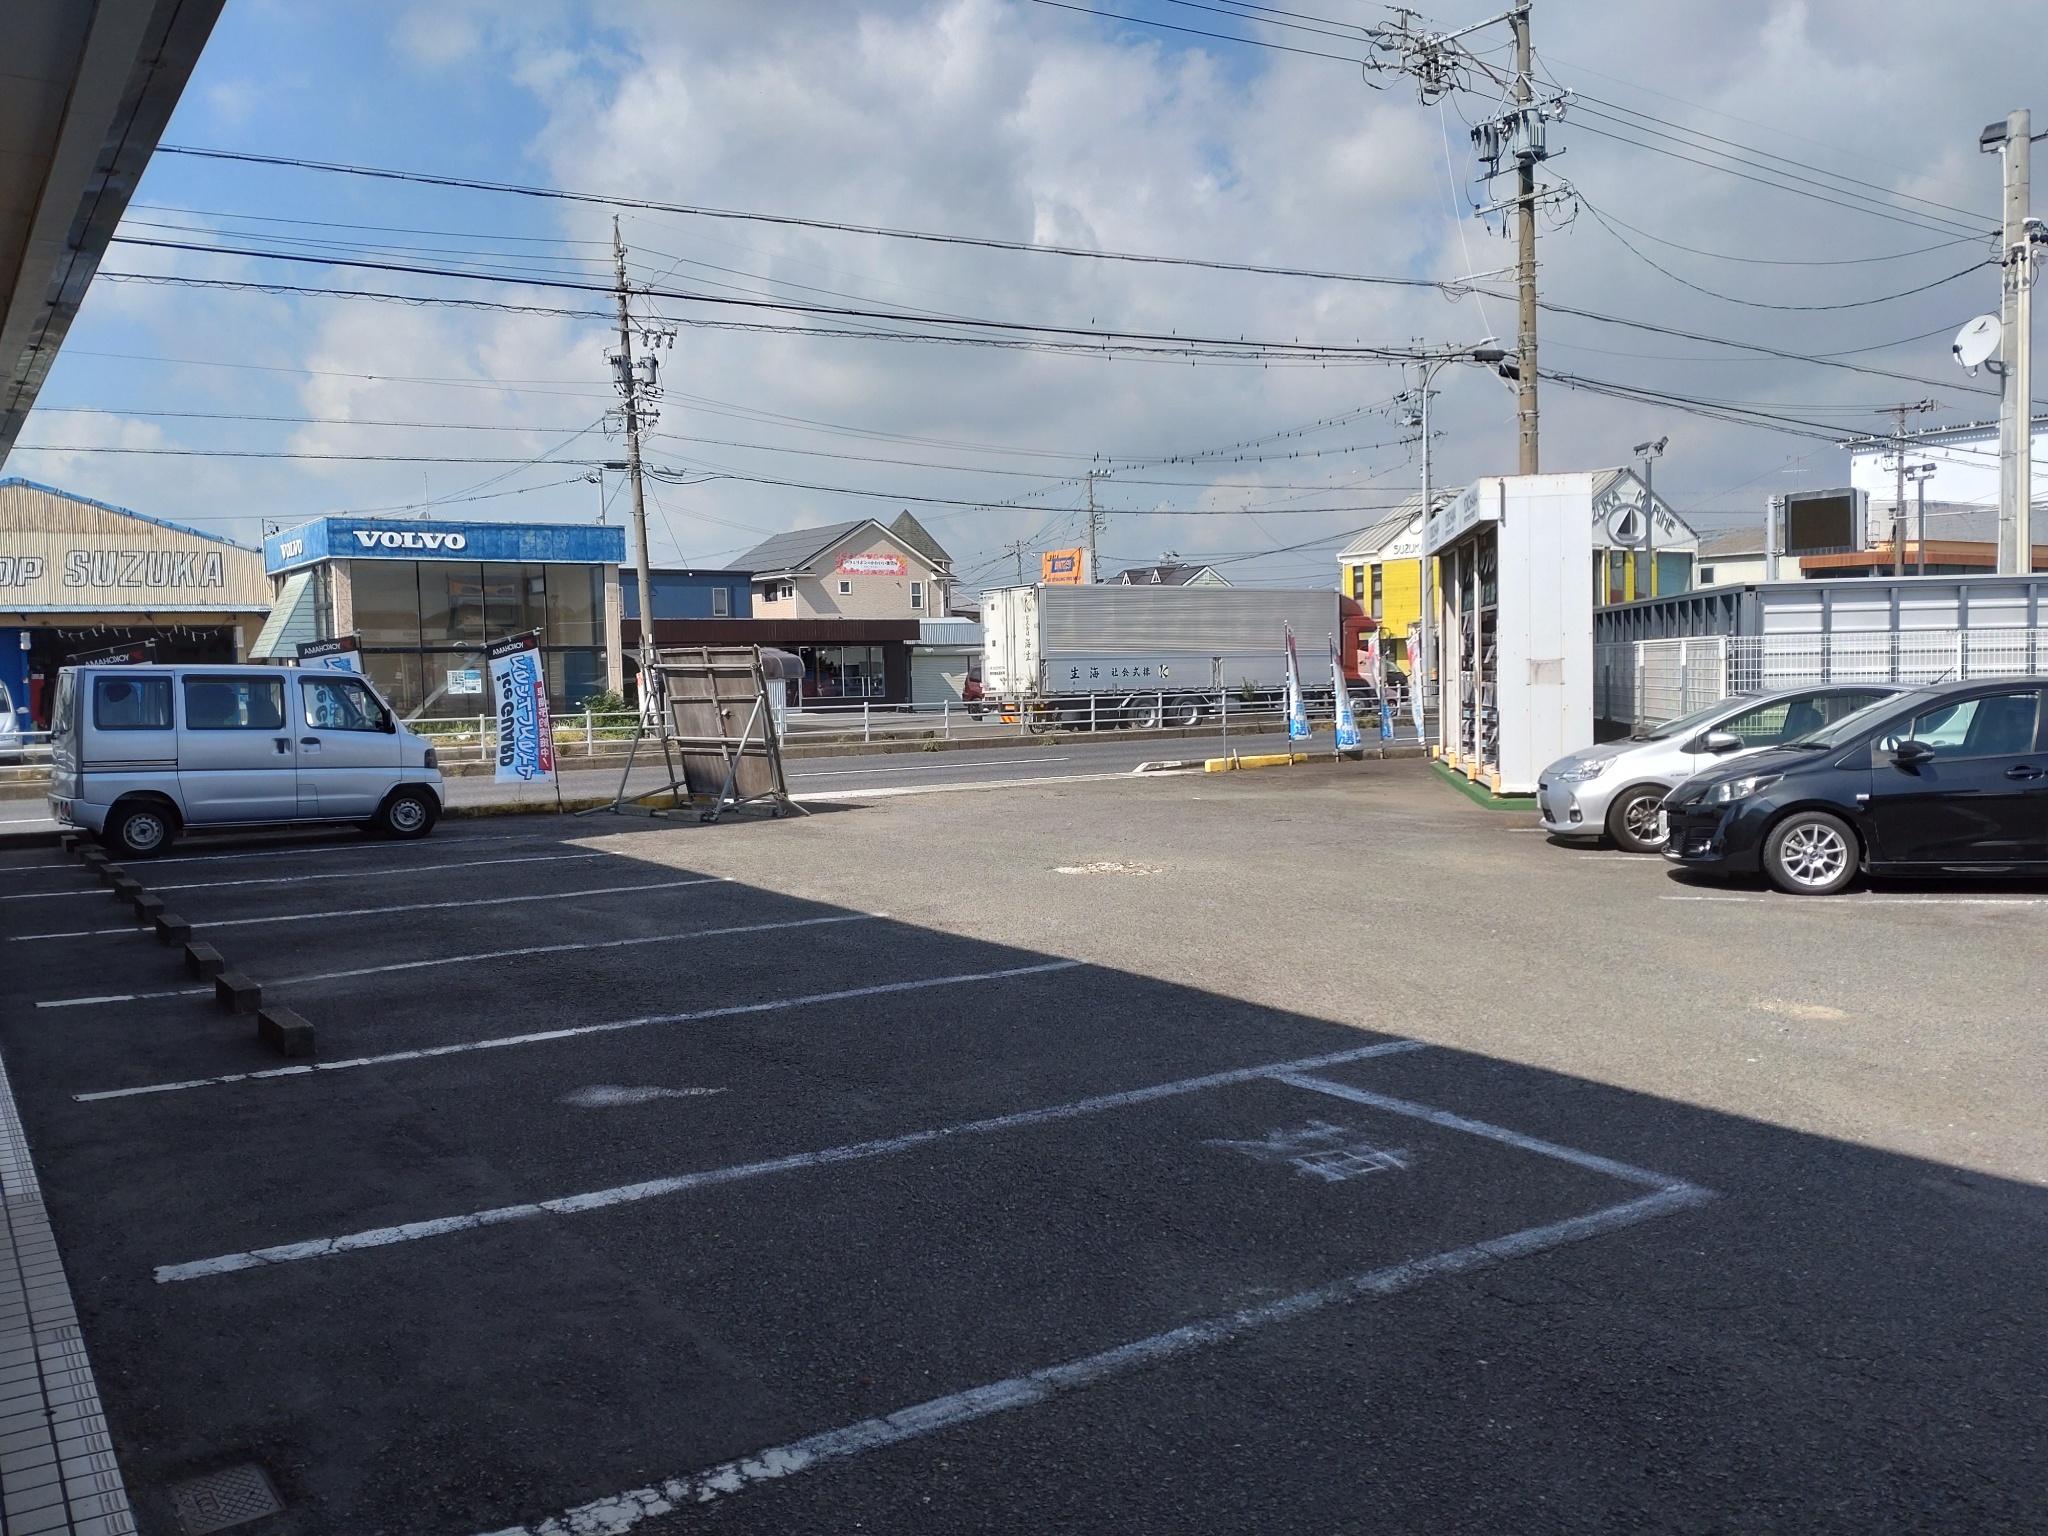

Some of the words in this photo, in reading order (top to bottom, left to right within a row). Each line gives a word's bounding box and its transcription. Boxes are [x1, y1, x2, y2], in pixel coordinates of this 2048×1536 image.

[1592, 489, 1622, 524] ZUKA
[1634, 489, 1676, 538] MRINE
[280, 539, 303, 560] VOLVO
[353, 530, 467, 550] VOLVO
[64, 550, 225, 588] SUZUKA
